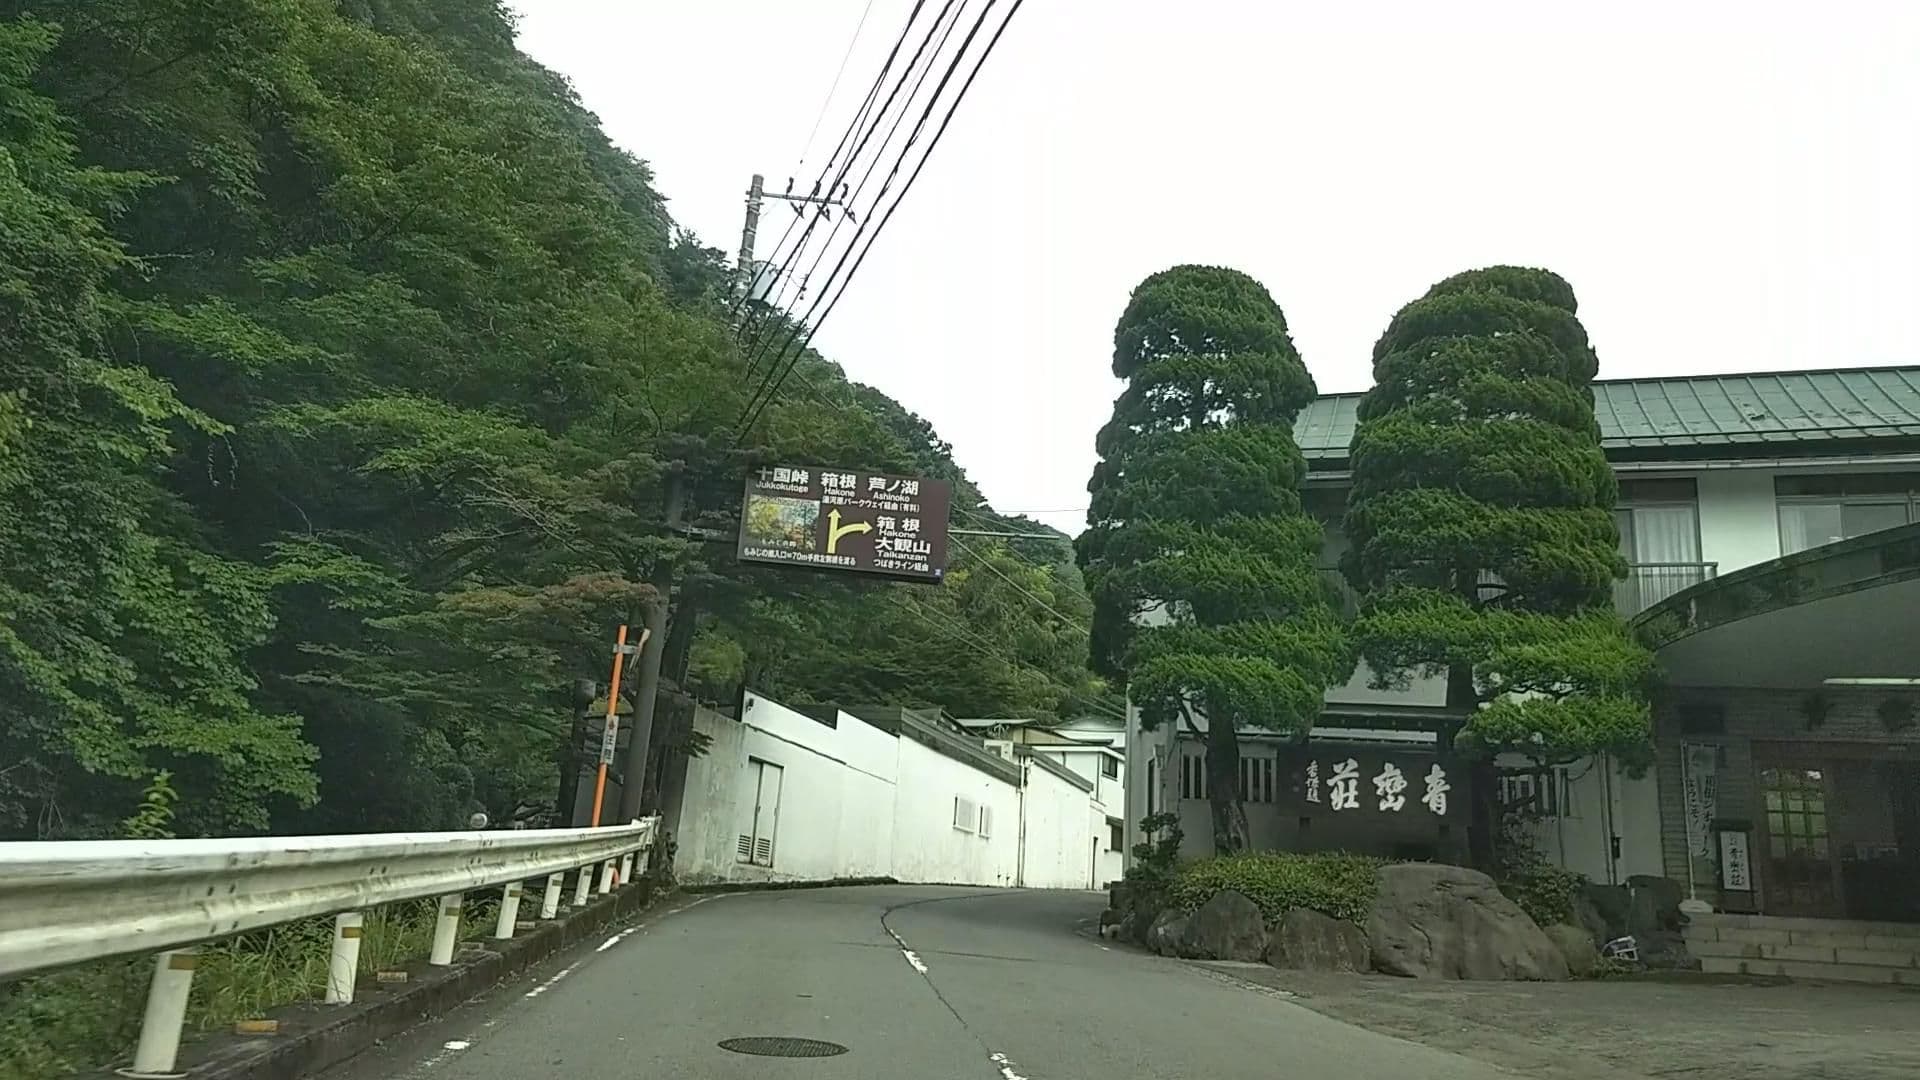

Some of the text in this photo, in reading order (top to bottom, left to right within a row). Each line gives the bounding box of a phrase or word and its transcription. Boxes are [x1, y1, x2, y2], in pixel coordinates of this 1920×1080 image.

[755, 466, 919, 496] 十国峠 箱根 芦ノ湖
[756, 481, 911, 503] Jukkokutoge Hakone Ashinoko
[876, 515, 920, 532] 箱根
[878, 528, 917, 540] Hakone
[874, 536, 932, 555] 大観山
